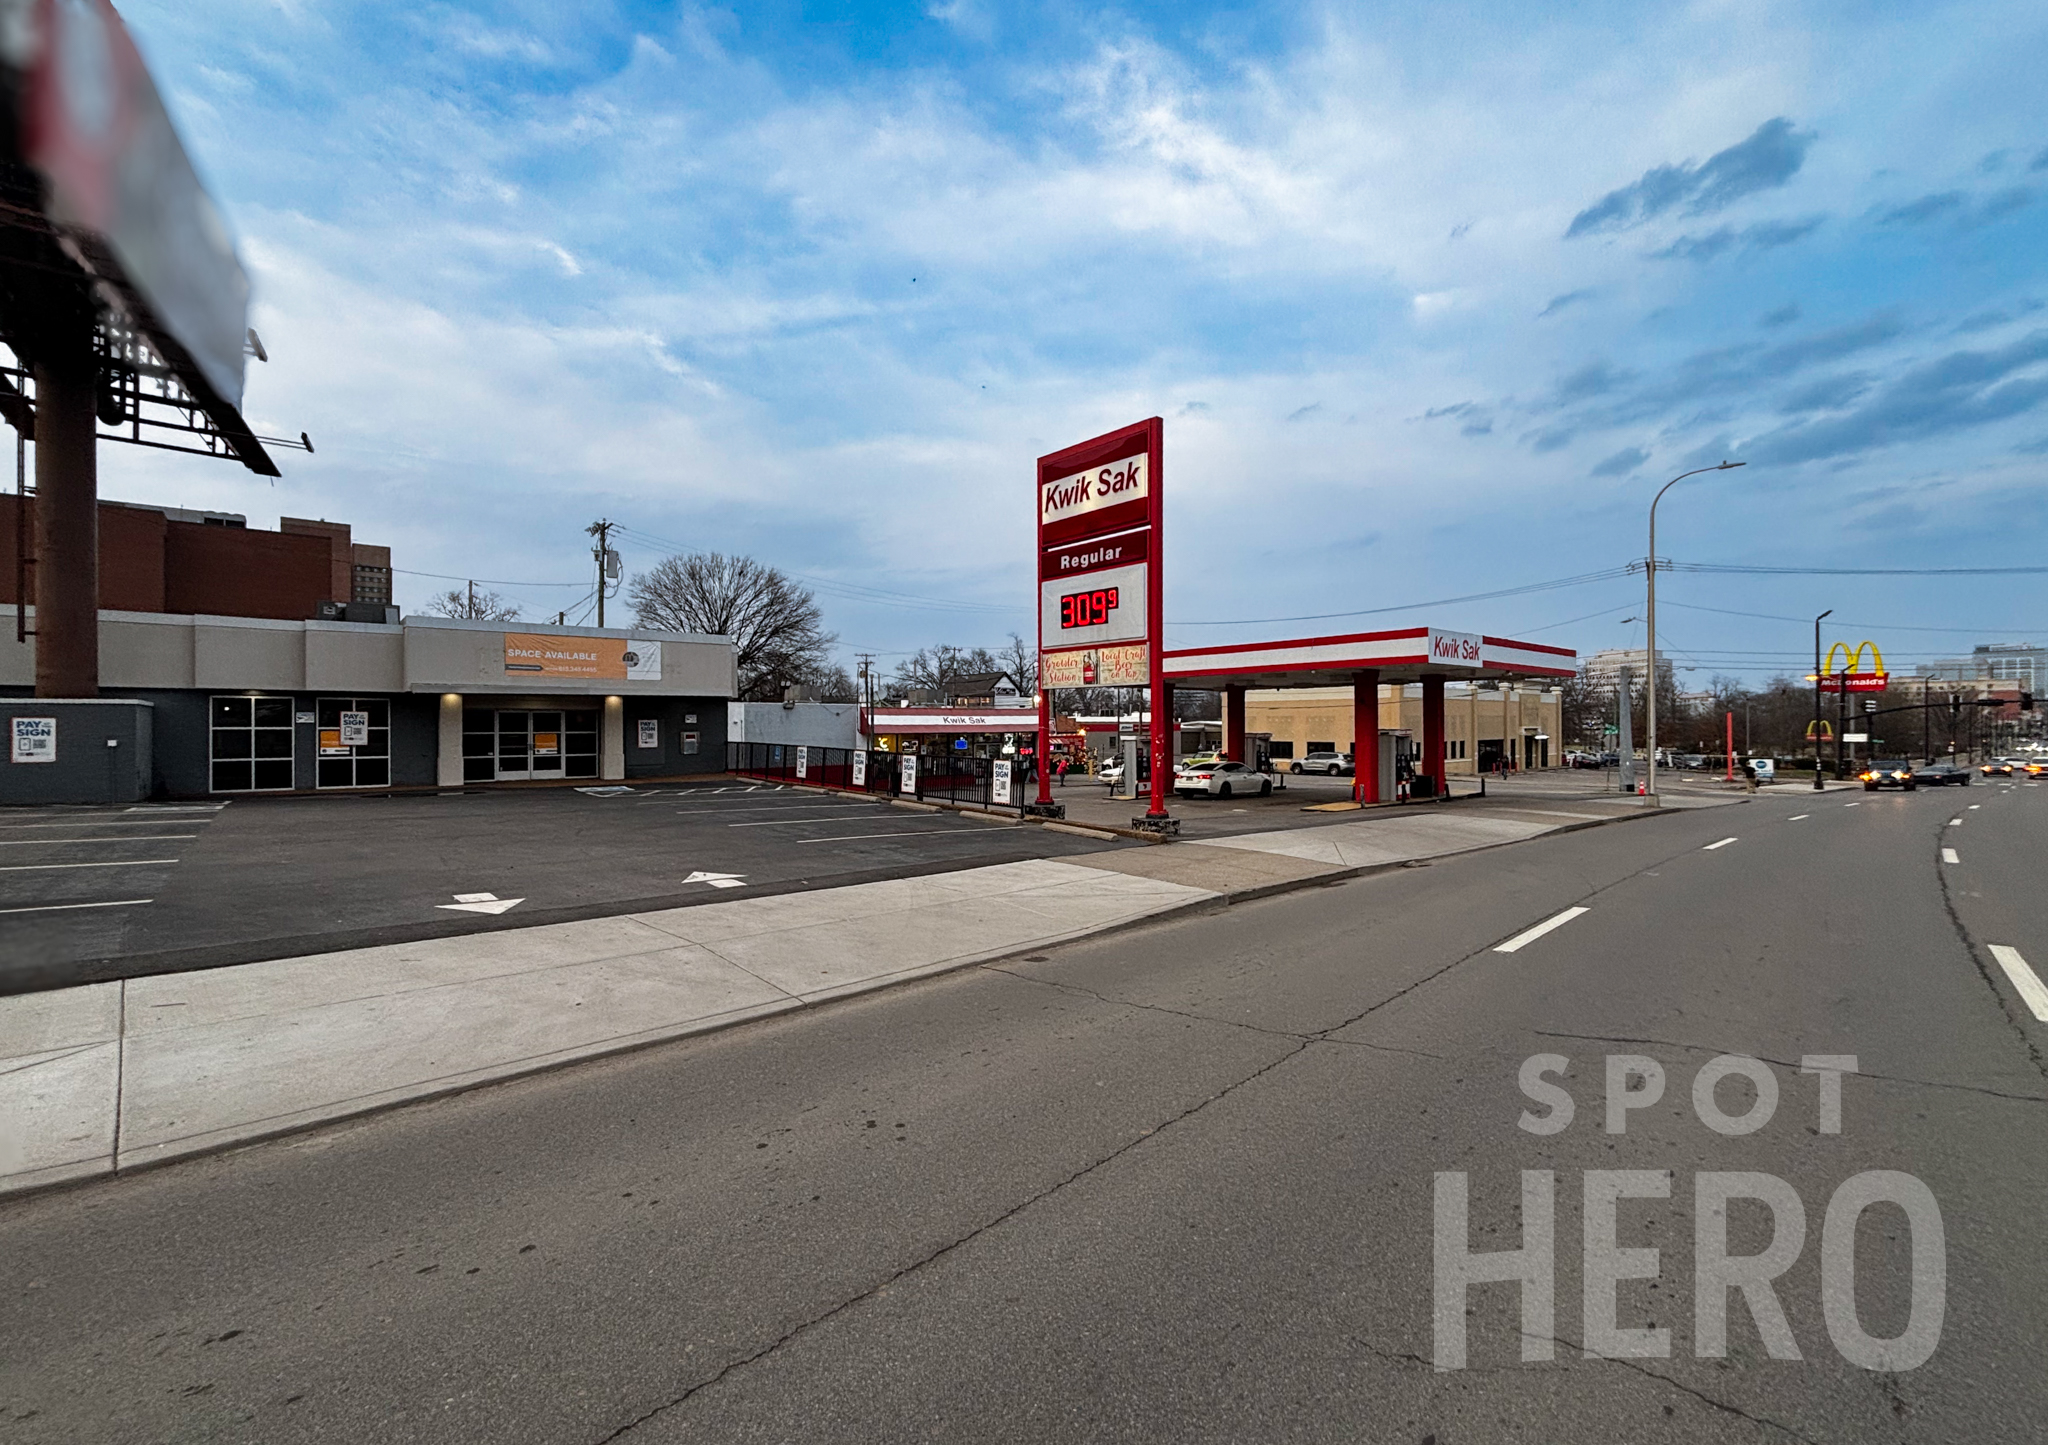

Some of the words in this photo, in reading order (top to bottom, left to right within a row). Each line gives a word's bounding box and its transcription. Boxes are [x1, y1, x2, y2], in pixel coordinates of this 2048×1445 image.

[1045, 475, 1092, 513] Kwik
[1097, 461, 1141, 497] Sak
[1060, 547, 1122, 569] Regular
[1434, 635, 1460, 659] Kwik
[1462, 639, 1480, 661] Sak
[507, 648, 542, 659] SPACE
[545, 650, 598, 661] AVAILABLE
[1101, 650, 1121, 663] Local
[1125, 646, 1146, 661] Craft
[1115, 660, 1133, 671] Beer
[1049, 670, 1077, 683] Station
[1111, 671, 1119, 679] on
[1125, 669, 1137, 679] Tap
[16, 720, 42, 729] PAY
[943, 716, 966, 724] Kwik
[968, 716, 987, 725] Sak
[17, 729, 51, 737] SIGN
[904, 763, 914, 771] SIGN
[995, 770, 1008, 779] SIGN
